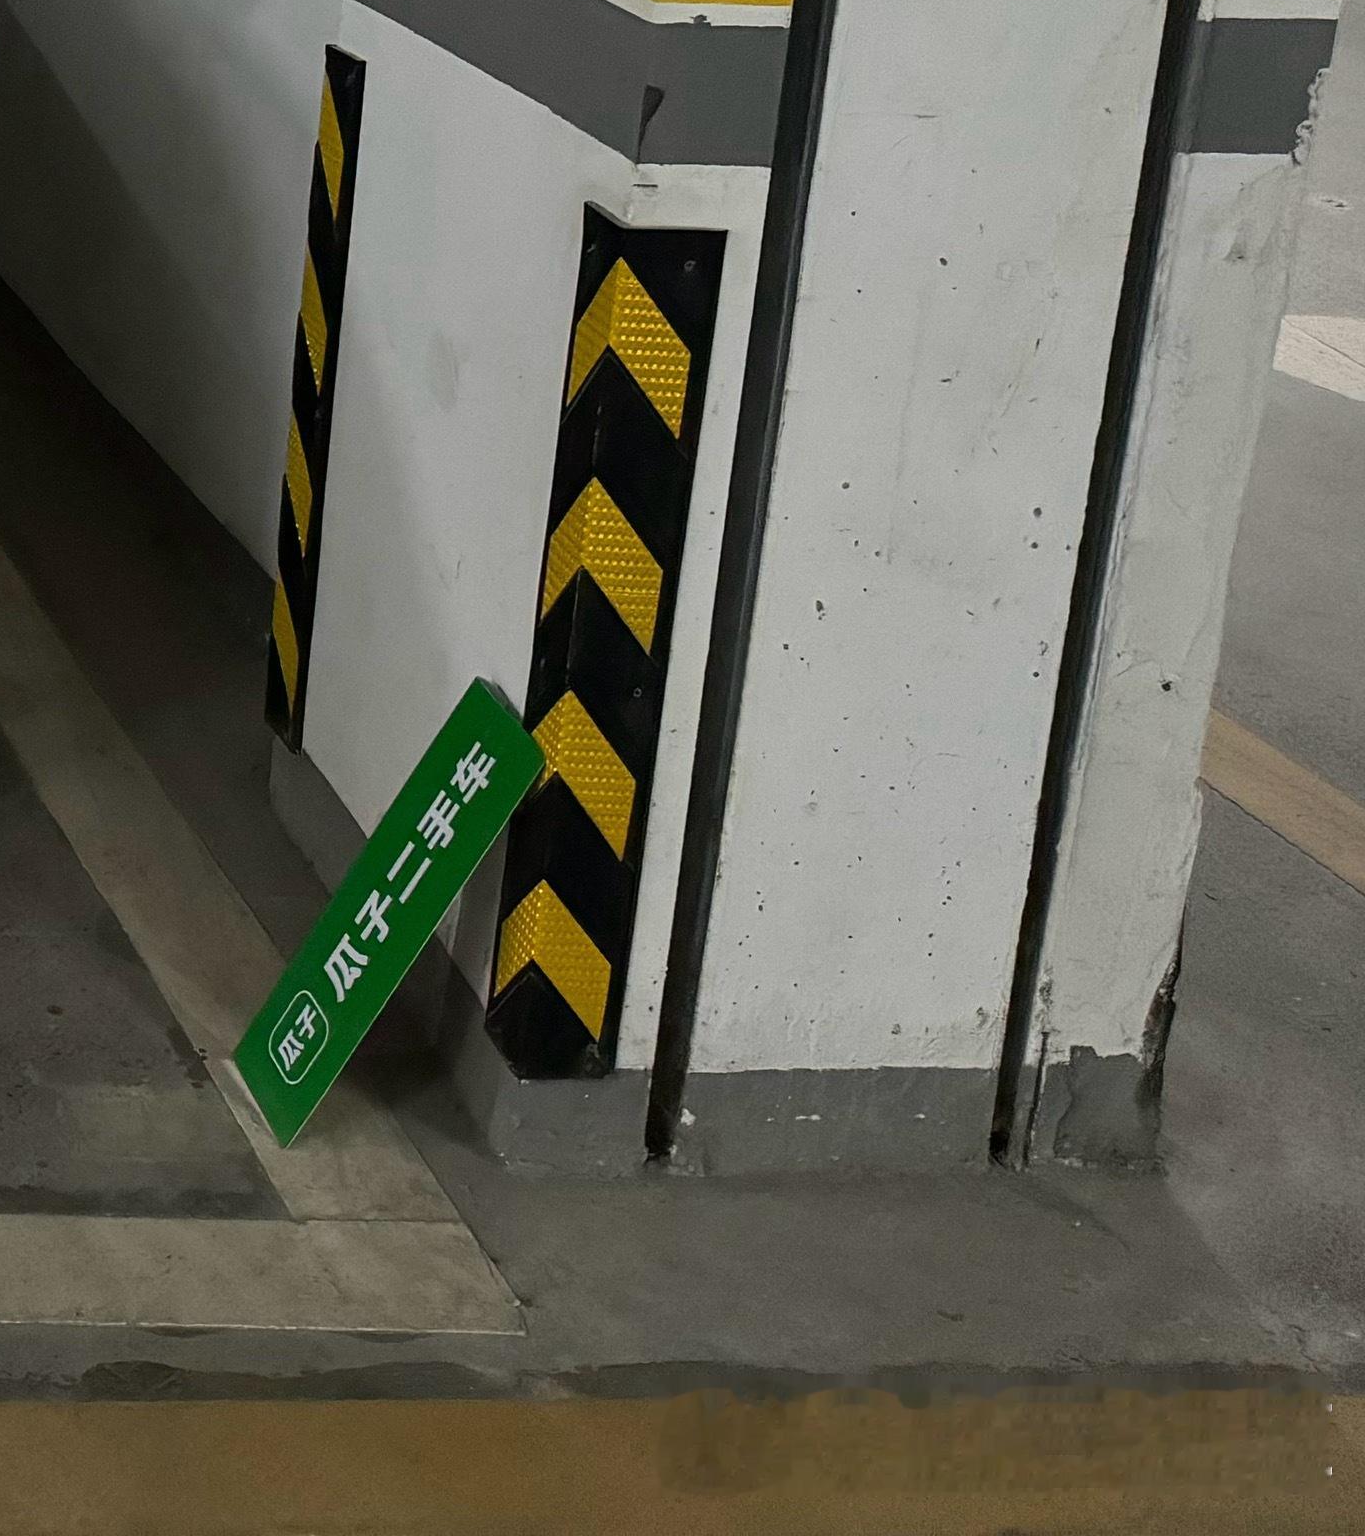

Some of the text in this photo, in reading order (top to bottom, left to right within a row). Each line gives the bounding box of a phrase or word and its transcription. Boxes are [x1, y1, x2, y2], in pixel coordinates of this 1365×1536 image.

[276, 740, 497, 1071] 瓜子 瓜子二手车
